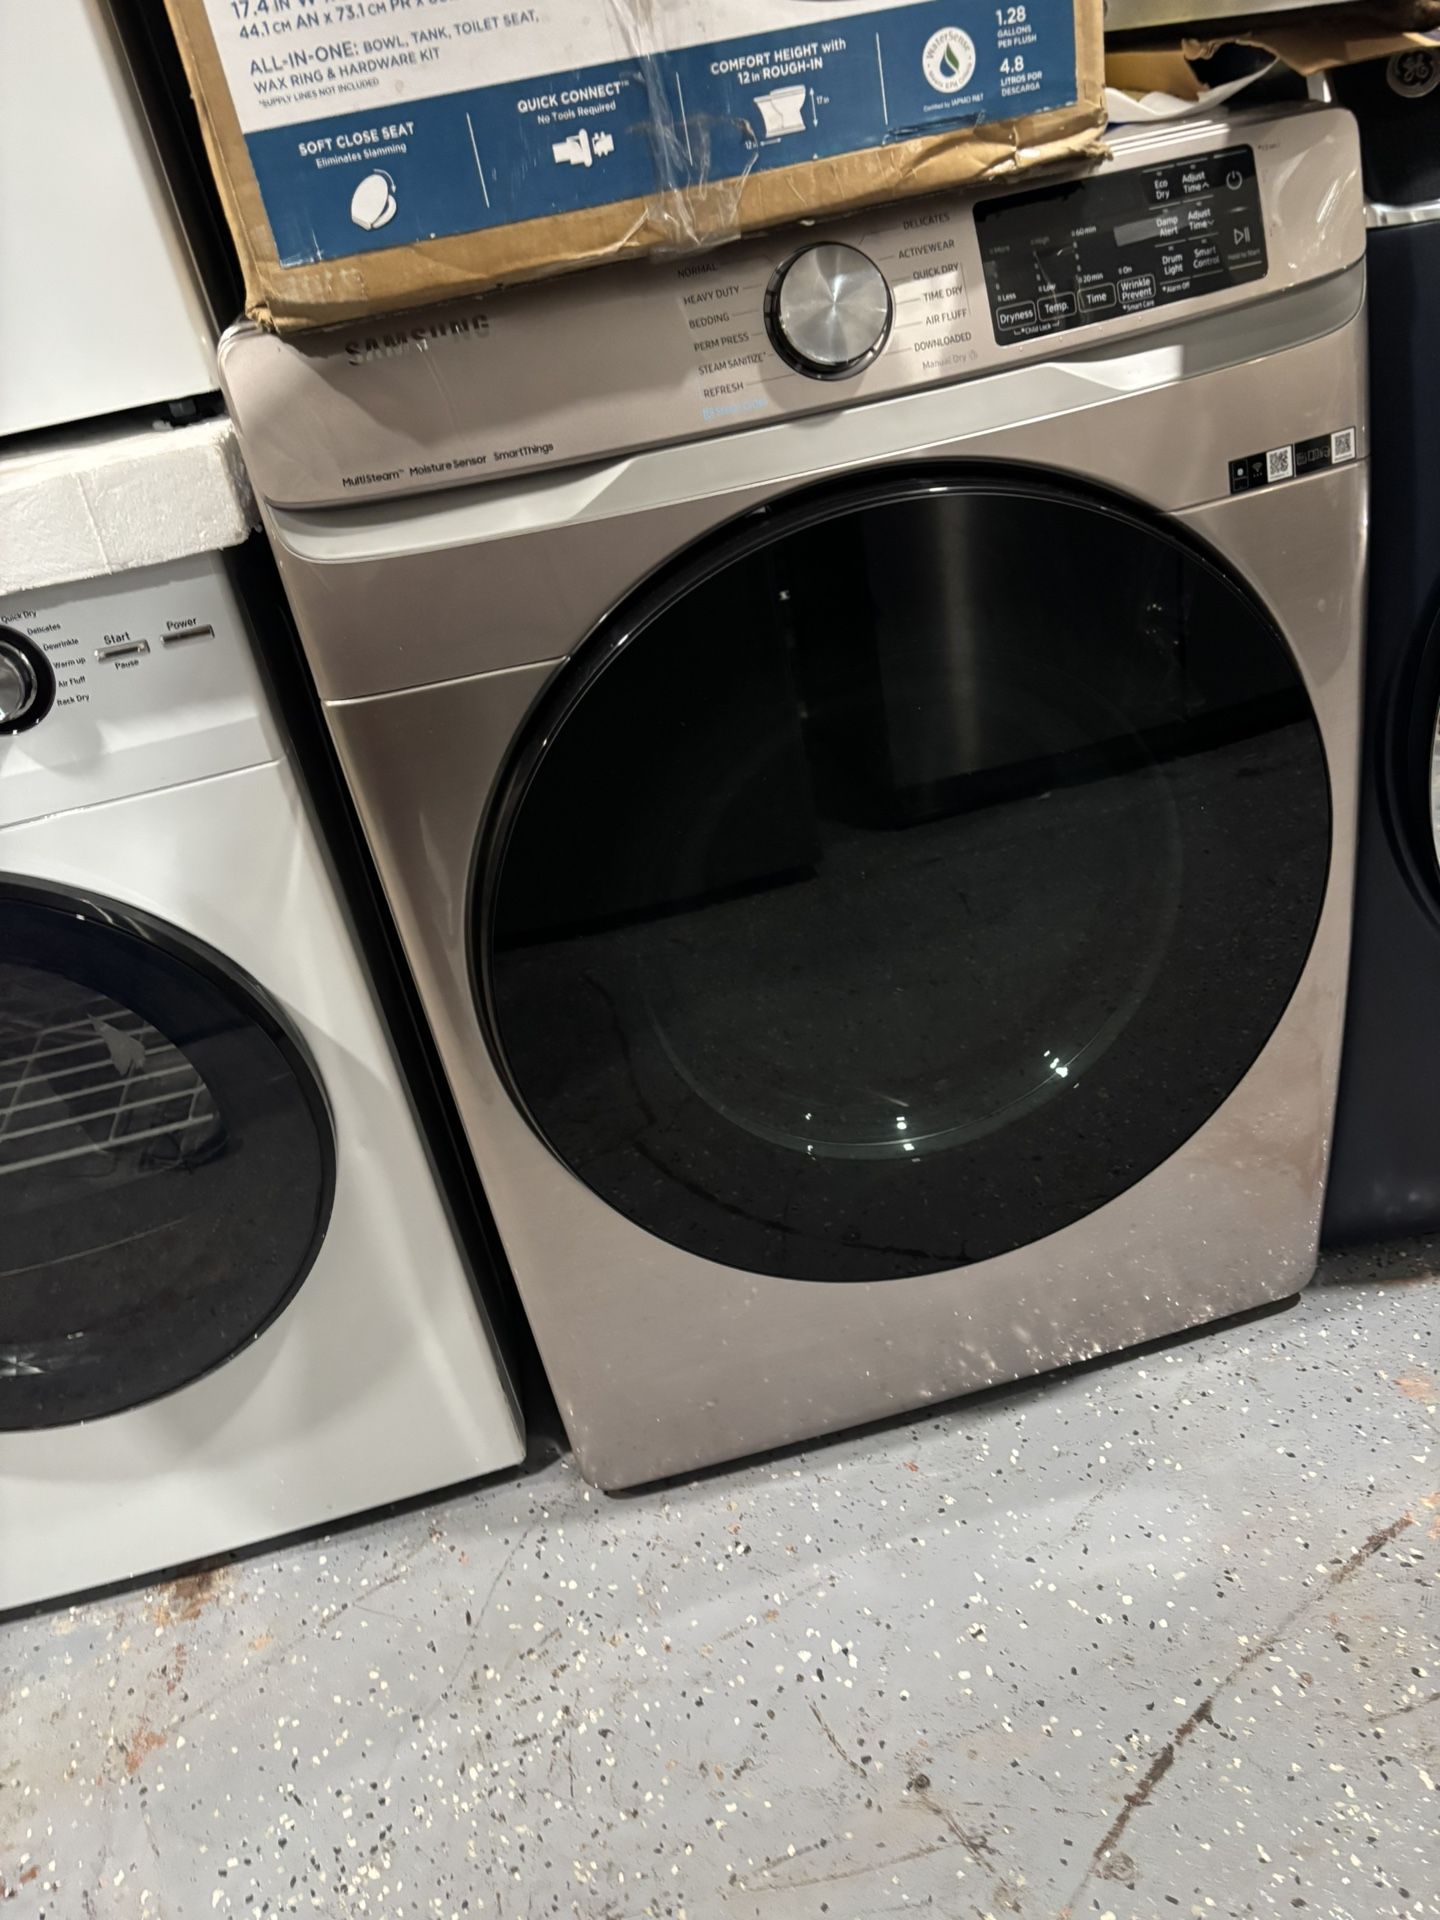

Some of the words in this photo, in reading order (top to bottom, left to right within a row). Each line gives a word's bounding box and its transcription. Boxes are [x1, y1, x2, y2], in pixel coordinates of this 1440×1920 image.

[231, 0, 269, 19] 17.4
[995, 5, 1026, 27] 1.28
[240, 21, 270, 39] 44.1
[273, 20, 292, 33] CM
[297, 12, 320, 29] AN
[336, 3, 365, 22] 73.1
[368, 3, 387, 16] CM
[390, 0, 411, 12] PR
[997, 24, 1032, 39] GALLONS
[250, 41, 360, 75] ALL-IN-ONE:
[363, 36, 409, 54] BOWL,
[411, 26, 452, 44] TANK,
[454, 16, 499, 35] TOILET
[503, 9, 539, 27] SEAT,
[997, 39, 1013, 49] PER
[1014, 34, 1037, 46] FLUSH
[710, 52, 771, 75] COMFORT
[774, 42, 819, 62] HEIGHT
[821, 37, 847, 54] with
[253, 74, 287, 95] WAX
[290, 67, 323, 87] RING
[327, 67, 336, 80] &
[339, 50, 416, 77] HARDWARE
[420, 47, 440, 62] KIT
[738, 71, 751, 85] 12
[752, 71, 760, 83] in
[762, 56, 824, 80] ROUGH-IN
[1000, 55, 1024, 74] 4.8
[1000, 74, 1026, 87] LITROS
[1027, 70, 1043, 81] POR
[294, 88, 318, 102] LINES
[319, 85, 337, 97] NOT
[338, 77, 379, 93] INCLUDED
[1001, 82, 1040, 97] DESCARGA
[517, 94, 559, 114] QUICK
[537, 115, 551, 125] No
[551, 108, 576, 121] Tools
[577, 100, 617, 118] Required
[298, 138, 332, 157] SOFT
[336, 129, 380, 149] CLOSE
[381, 121, 415, 140] SEAT
[316, 152, 362, 169] Eliminates
[363, 142, 407, 160] Slamming
[1154, 179, 1168, 190] Eco
[1182, 171, 1206, 184] Adjust
[1155, 190, 1170, 200] Dry
[1183, 183, 1202, 194] Time
[903, 213, 950, 230] DELICATES
[1156, 216, 1179, 228] Damp
[1188, 208, 1211, 221] Adjust
[1160, 226, 1179, 237] Alert
[1189, 220, 1208, 231] Time
[898, 239, 955, 259] ACTIVEWEAR
[1194, 246, 1216, 258] Smart
[1162, 253, 1183, 265] Drum
[1193, 256, 1220, 269] Control
[678, 263, 719, 279] NORMAL
[912, 266, 940, 280] QUICK
[941, 262, 959, 274] DRY
[1123, 266, 1132, 274] On
[1164, 263, 1183, 276] Light
[1043, 283, 1056, 292] Low
[1120, 277, 1151, 291] Wrinkle
[683, 291, 714, 305] HEAVY
[715, 285, 740, 299] DUTY
[922, 288, 944, 302] TIME
[945, 285, 963, 298] DRY
[1002, 292, 1017, 302] Less
[1086, 293, 1107, 305] Time
[1121, 288, 1152, 301] Prevent
[1045, 301, 1070, 314] Temp.
[689, 312, 730, 329] BEDDING
[925, 314, 940, 326] AIR
[941, 308, 967, 322] FLUFF
[1000, 309, 1033, 324] Dryness
[345, 314, 490, 366] SAMSUNG
[694, 338, 720, 352] PERM
[721, 332, 750, 346] PRESS
[913, 331, 972, 352] DOWNLOADED
[952, 353, 967, 364] Dry
[698, 362, 727, 376] STEAM
[703, 381, 744, 399] REFRESH
[409, 461, 452, 478] Moisture
[453, 454, 488, 470] Sensor
[493, 442, 554, 462] SmartThings
[1, 612, 22, 624] Quick
[23, 610, 37, 620] Dry
[166, 617, 197, 631] Power
[27, 623, 61, 635] Delicates
[43, 638, 79, 651] Dewrinkle
[103, 631, 131, 645] Start
[54, 659, 75, 670] Warm
[76, 656, 86, 666] up
[114, 658, 140, 671] Pause
[58, 680, 68, 688] Air
[69, 675, 86, 685] Fluff
[57, 696, 75, 707] Rack
[76, 694, 90, 702] Dry
